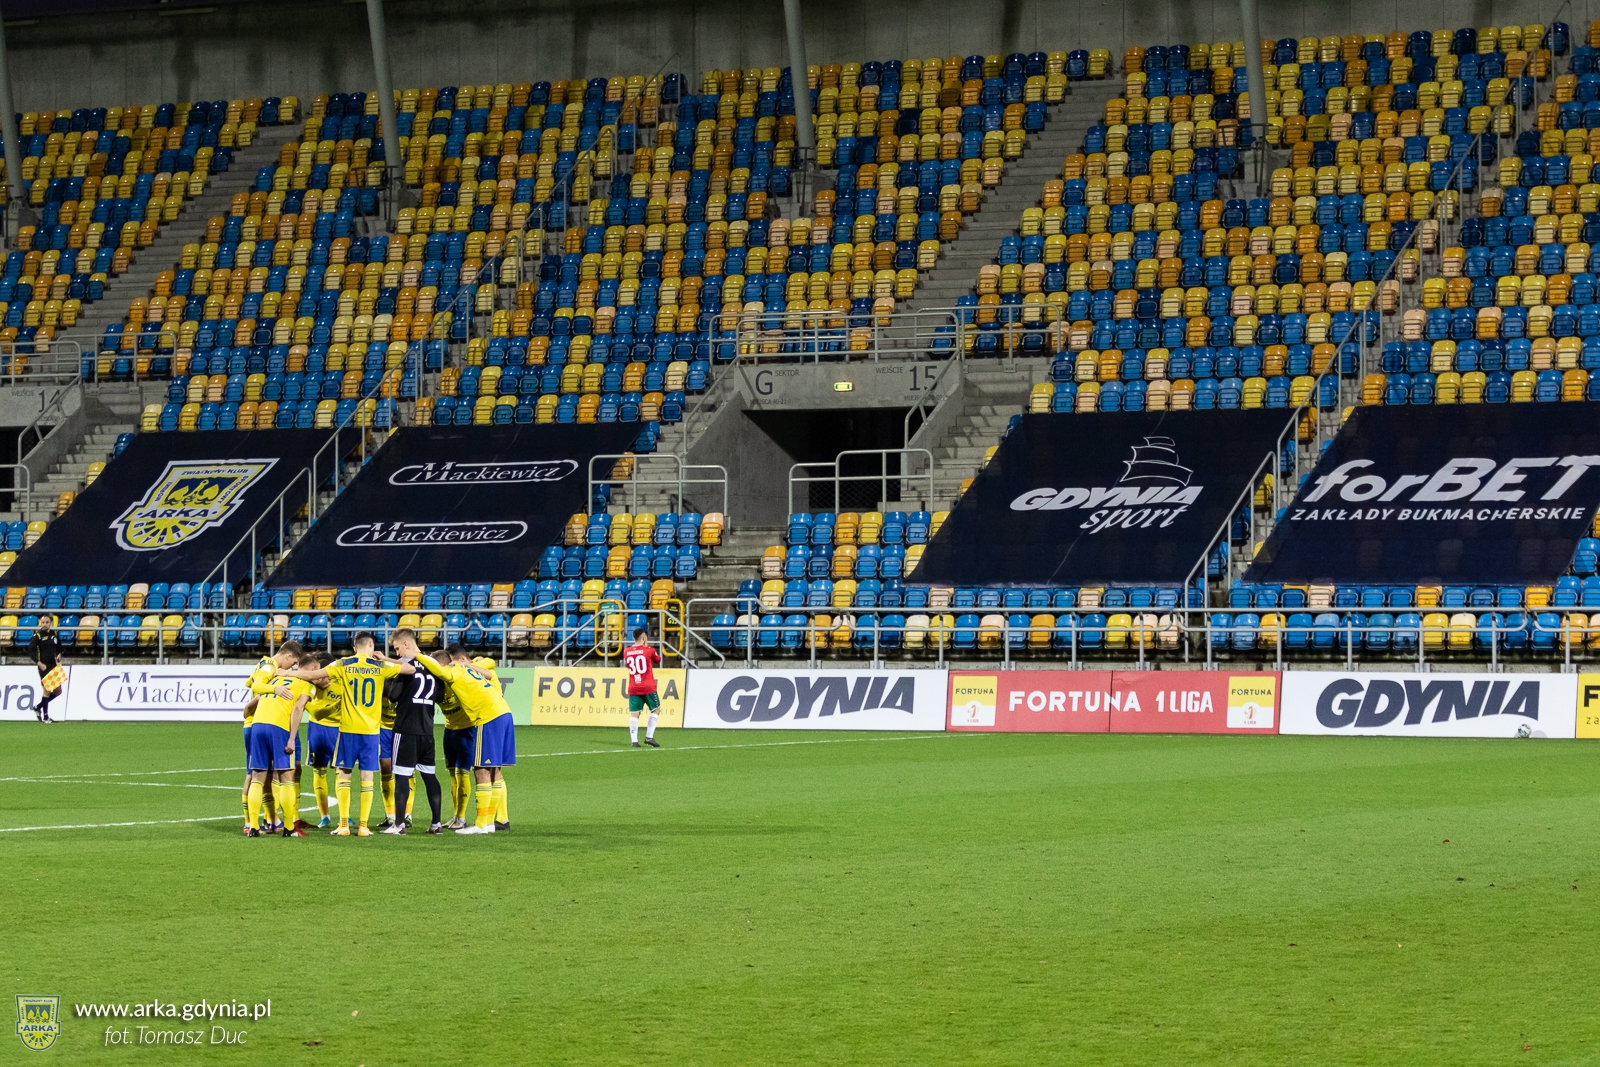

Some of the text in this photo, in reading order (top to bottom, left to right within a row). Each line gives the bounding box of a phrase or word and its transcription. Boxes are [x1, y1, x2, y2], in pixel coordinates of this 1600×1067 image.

[774, 369, 800, 377] SEKTOR
[875, 365, 903, 374] WEJŚCIE
[909, 365, 938, 391] 15
[755, 370, 773, 396] G
[407, 461, 561, 482] Mackiewicz
[1302, 454, 1600, 502] forBET
[1009, 485, 1204, 511] GDYNIA
[140, 507, 209, 519] ARKA
[1080, 504, 1190, 535] sport
[1290, 507, 1586, 521] ZAKŁADY BUKMACHERSKIE
[355, 521, 509, 543] Mackiewicz
[345, 666, 380, 675] LETNIOWSKI
[626, 655, 648, 676] 30
[0, 684, 35, 711] ra
[115, 671, 251, 704] Mackiewicz
[349, 677, 375, 708] 10
[412, 672, 436, 706] 22
[538, 677, 679, 700] FORTUA
[716, 675, 915, 723] GDYNIA
[540, 704, 583, 716] zakłady
[1009, 690, 1214, 713] FORTUNA 1 LIGA
[1315, 678, 1540, 729] GDYNIA
